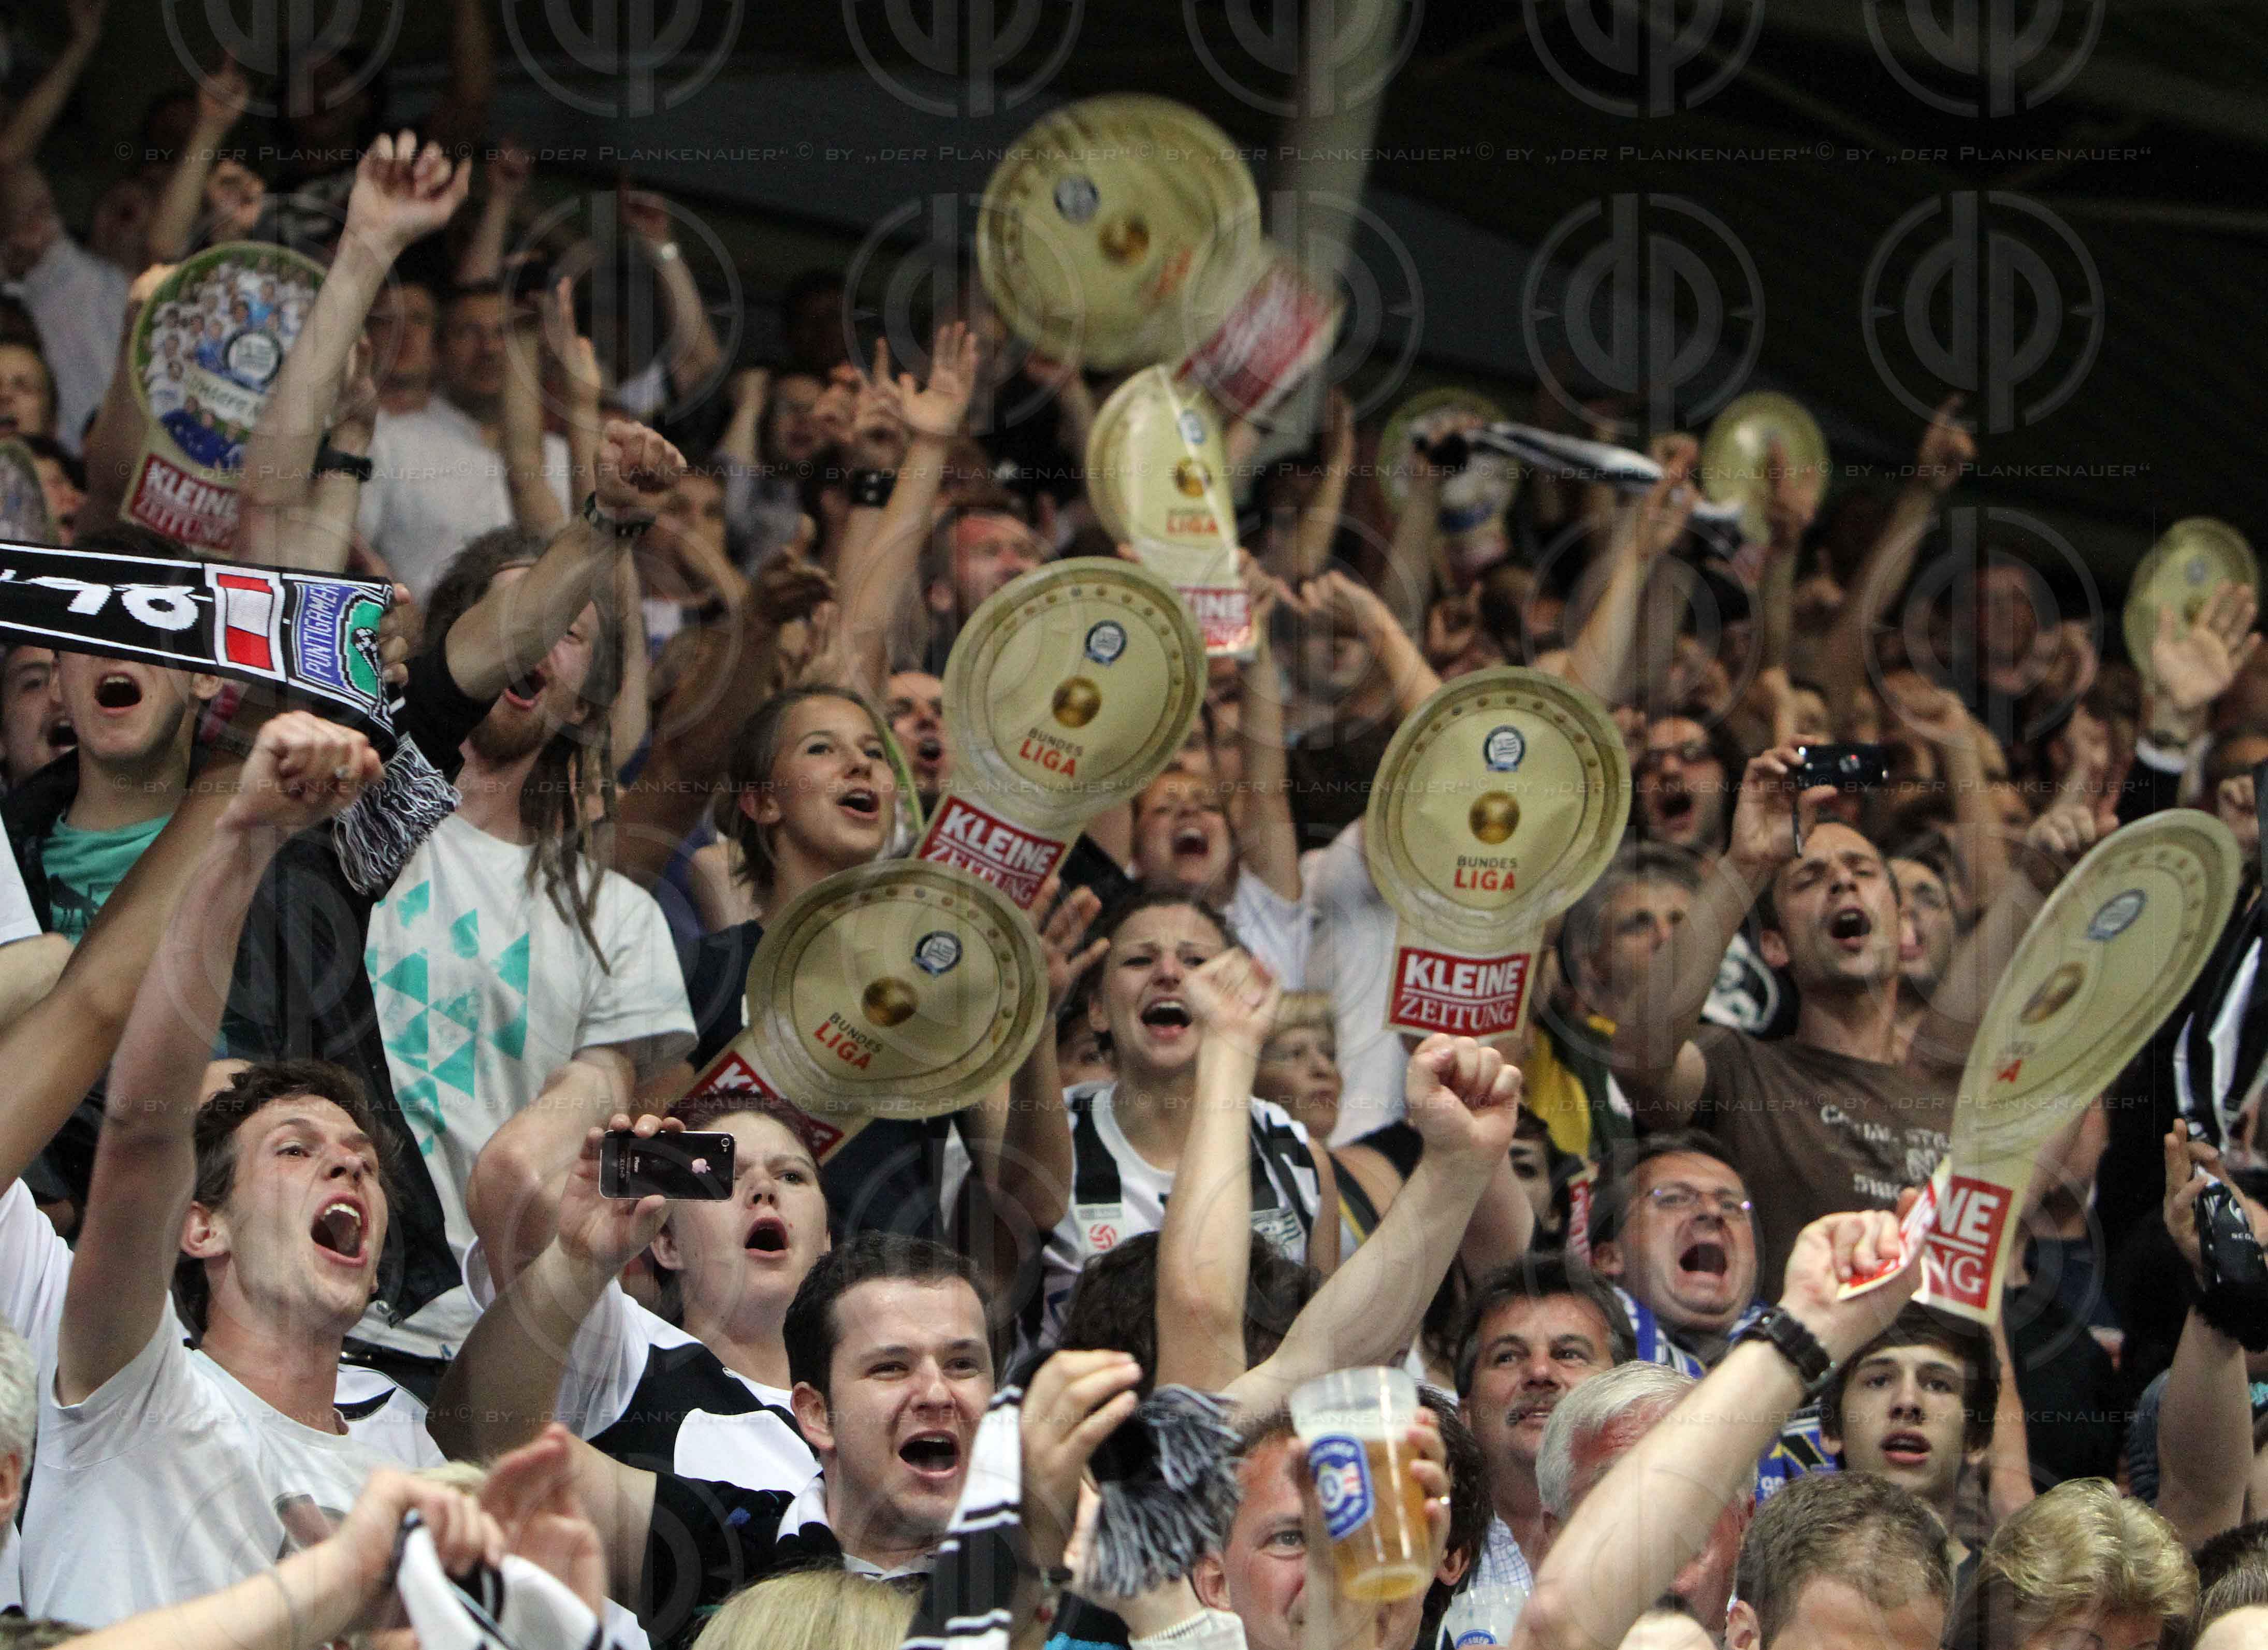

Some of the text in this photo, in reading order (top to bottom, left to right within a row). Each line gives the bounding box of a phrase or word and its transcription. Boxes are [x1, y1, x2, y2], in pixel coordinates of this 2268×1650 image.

[1019, 737, 1075, 779] LIGA
[940, 804, 1057, 874] KLEINE
[1454, 867, 1516, 891] LIGA
[1457, 855, 1518, 869] BUNDES
[1404, 953, 1523, 997] KLEINE
[1398, 993, 1514, 1031] ZEITUNG
[814, 1019, 872, 1069] LIGA
